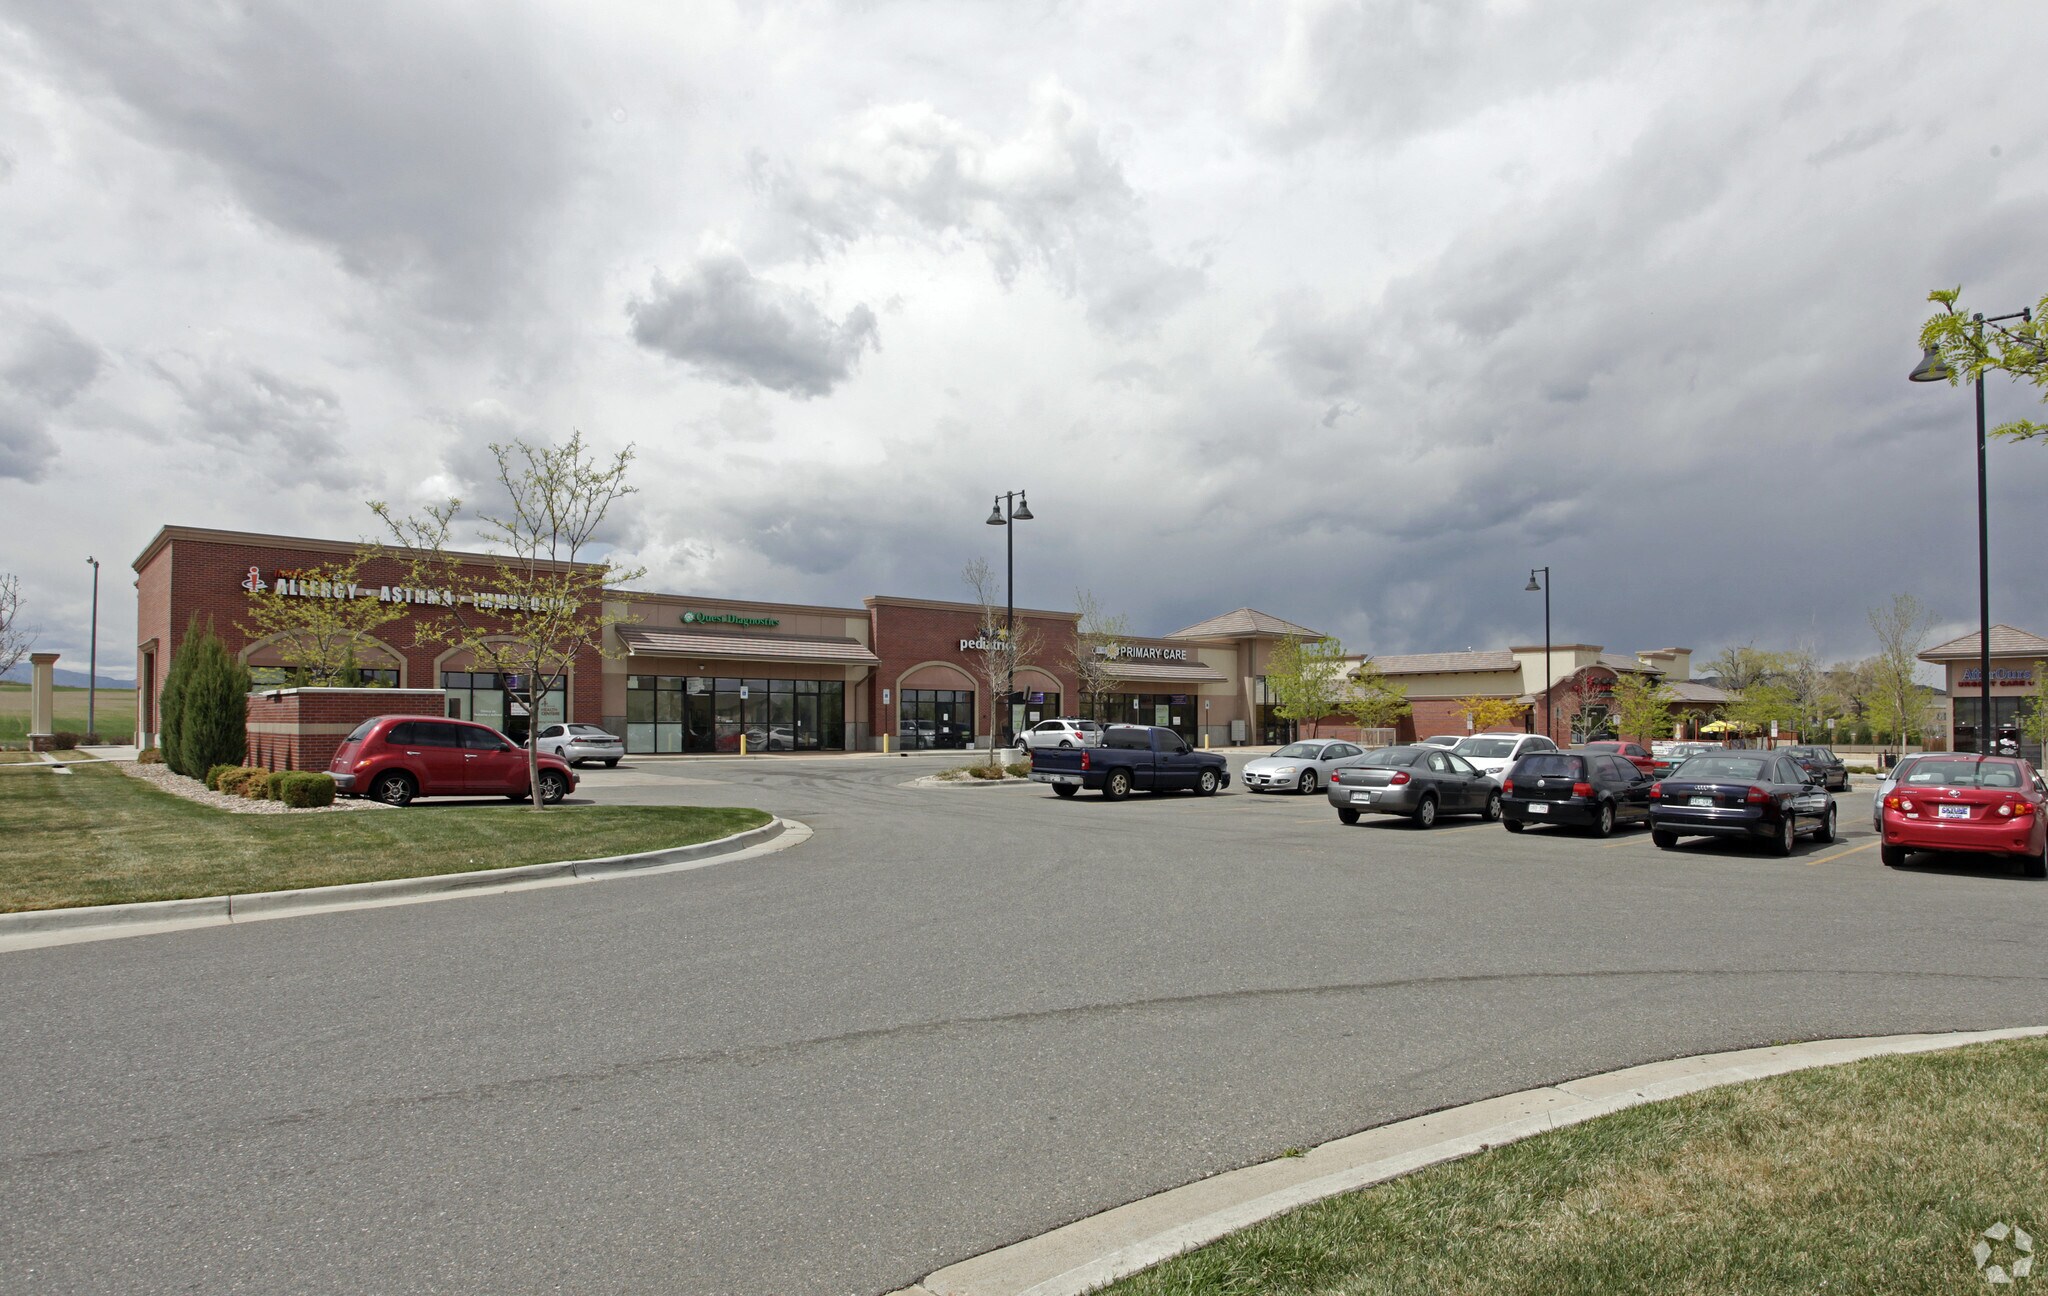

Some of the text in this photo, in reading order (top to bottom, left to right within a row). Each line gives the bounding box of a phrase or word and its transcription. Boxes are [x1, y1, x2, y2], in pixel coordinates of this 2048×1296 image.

[276, 578, 357, 599] ALLERGY
[696, 612, 725, 624] Quest
[1120, 641, 1161, 659] PRIMARY
[1163, 648, 1187, 661] CARE
[1962, 667, 2031, 681] AftrOurs
